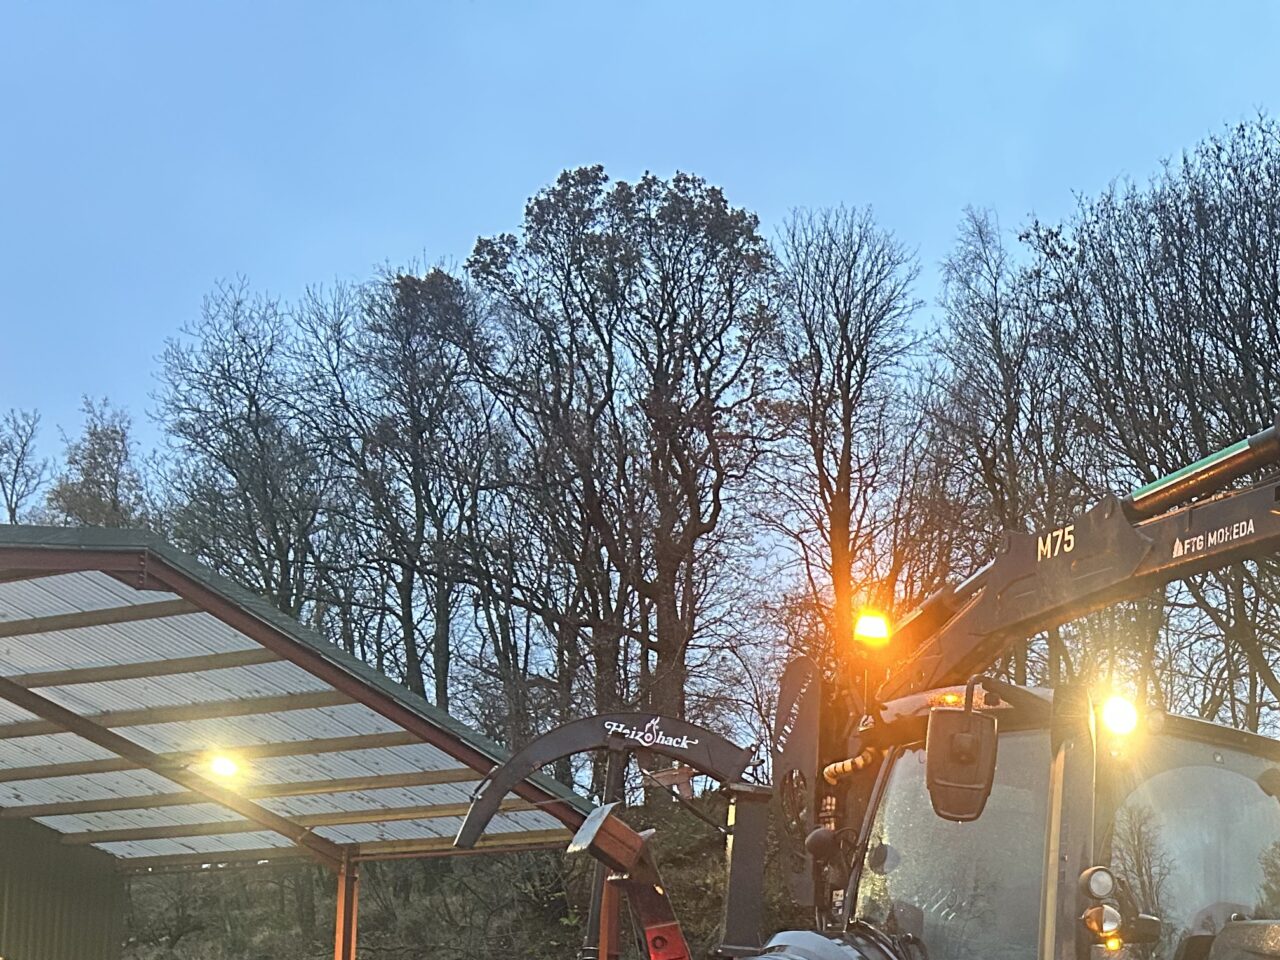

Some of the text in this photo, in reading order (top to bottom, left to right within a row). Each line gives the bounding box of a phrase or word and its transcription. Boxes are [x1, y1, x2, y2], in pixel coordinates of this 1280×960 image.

[1037, 524, 1075, 562] M75
[1183, 518, 1255, 555] FTG MOHEDA
